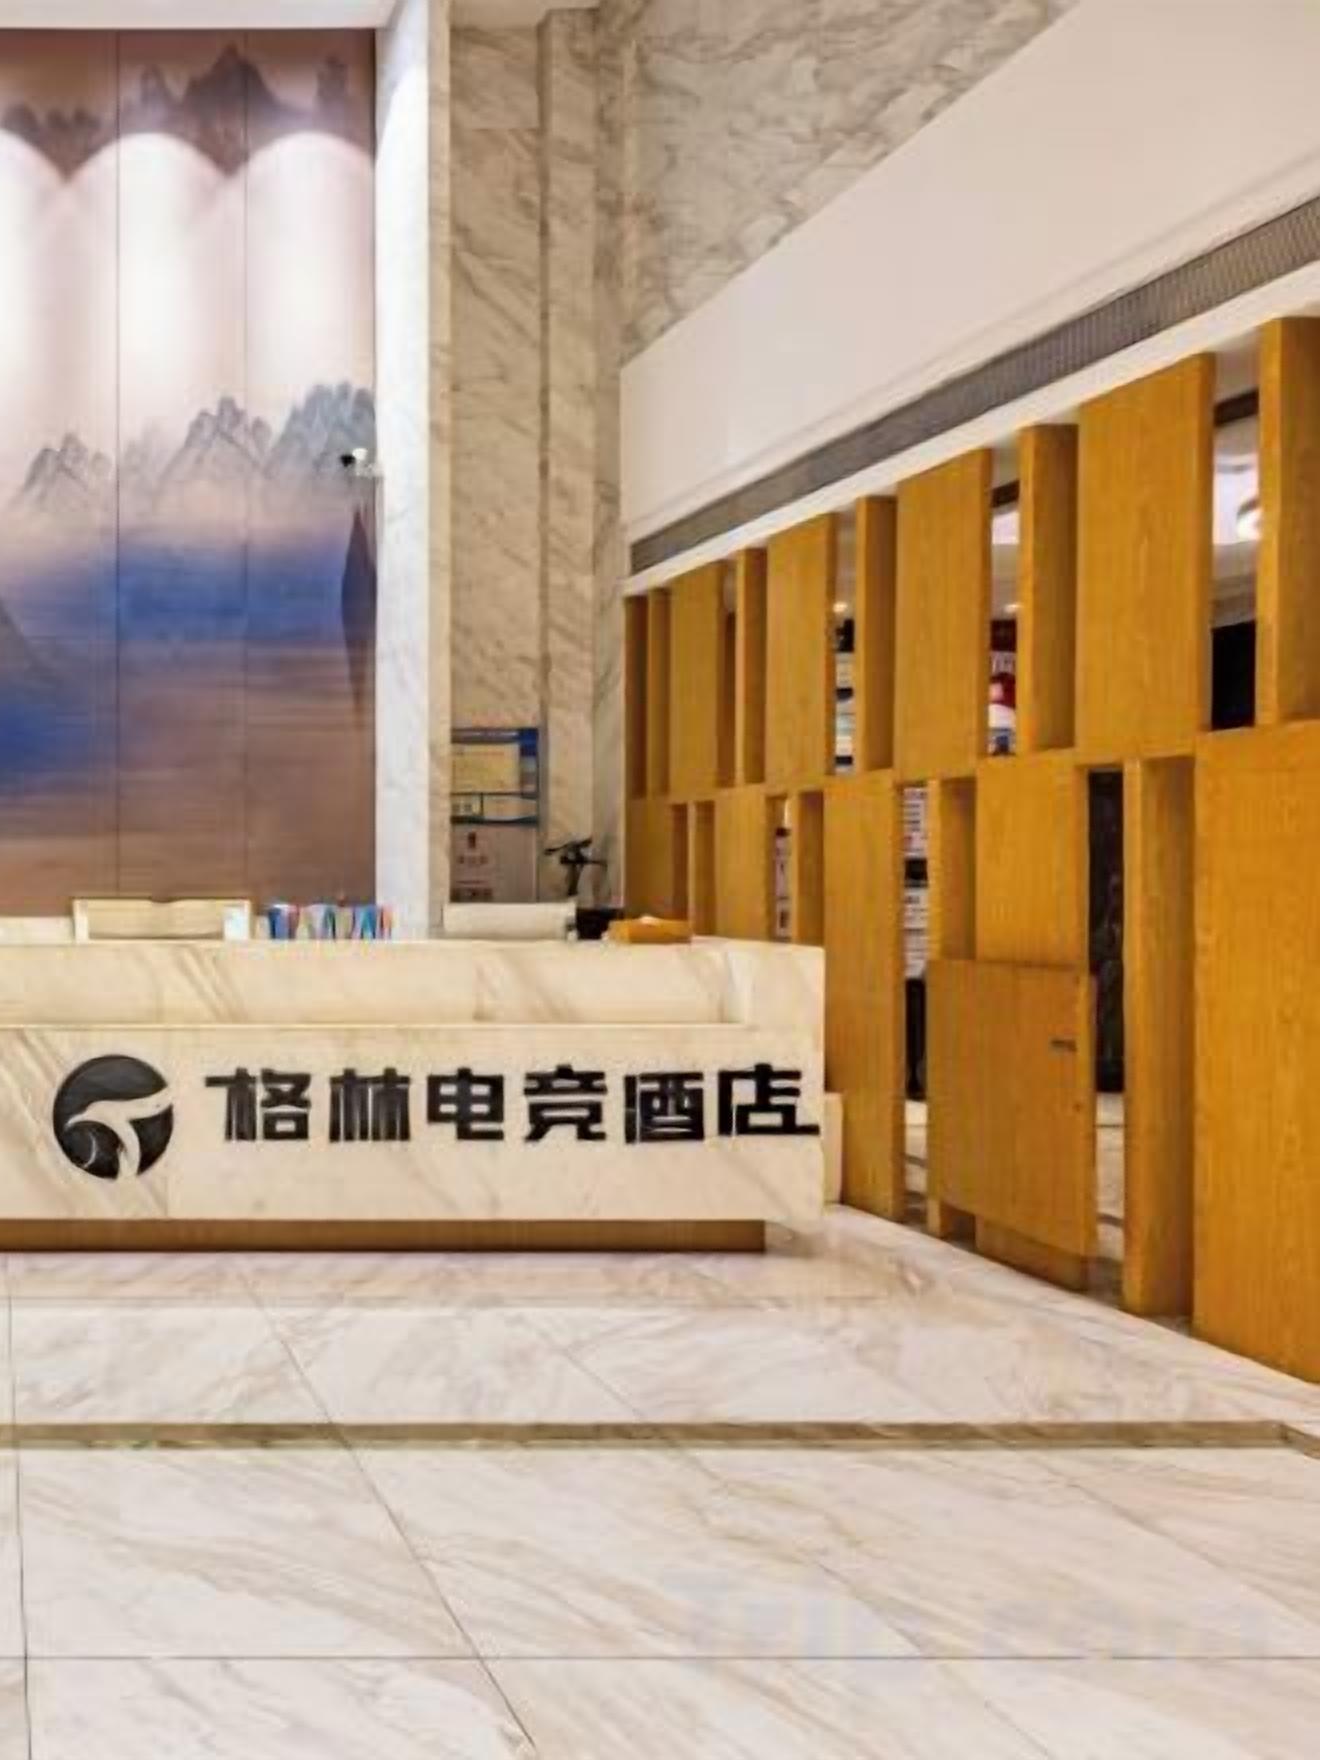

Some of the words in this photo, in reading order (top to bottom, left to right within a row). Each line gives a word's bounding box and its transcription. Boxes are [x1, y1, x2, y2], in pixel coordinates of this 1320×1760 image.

[205, 1064, 820, 1144] 格林电竞酒店
